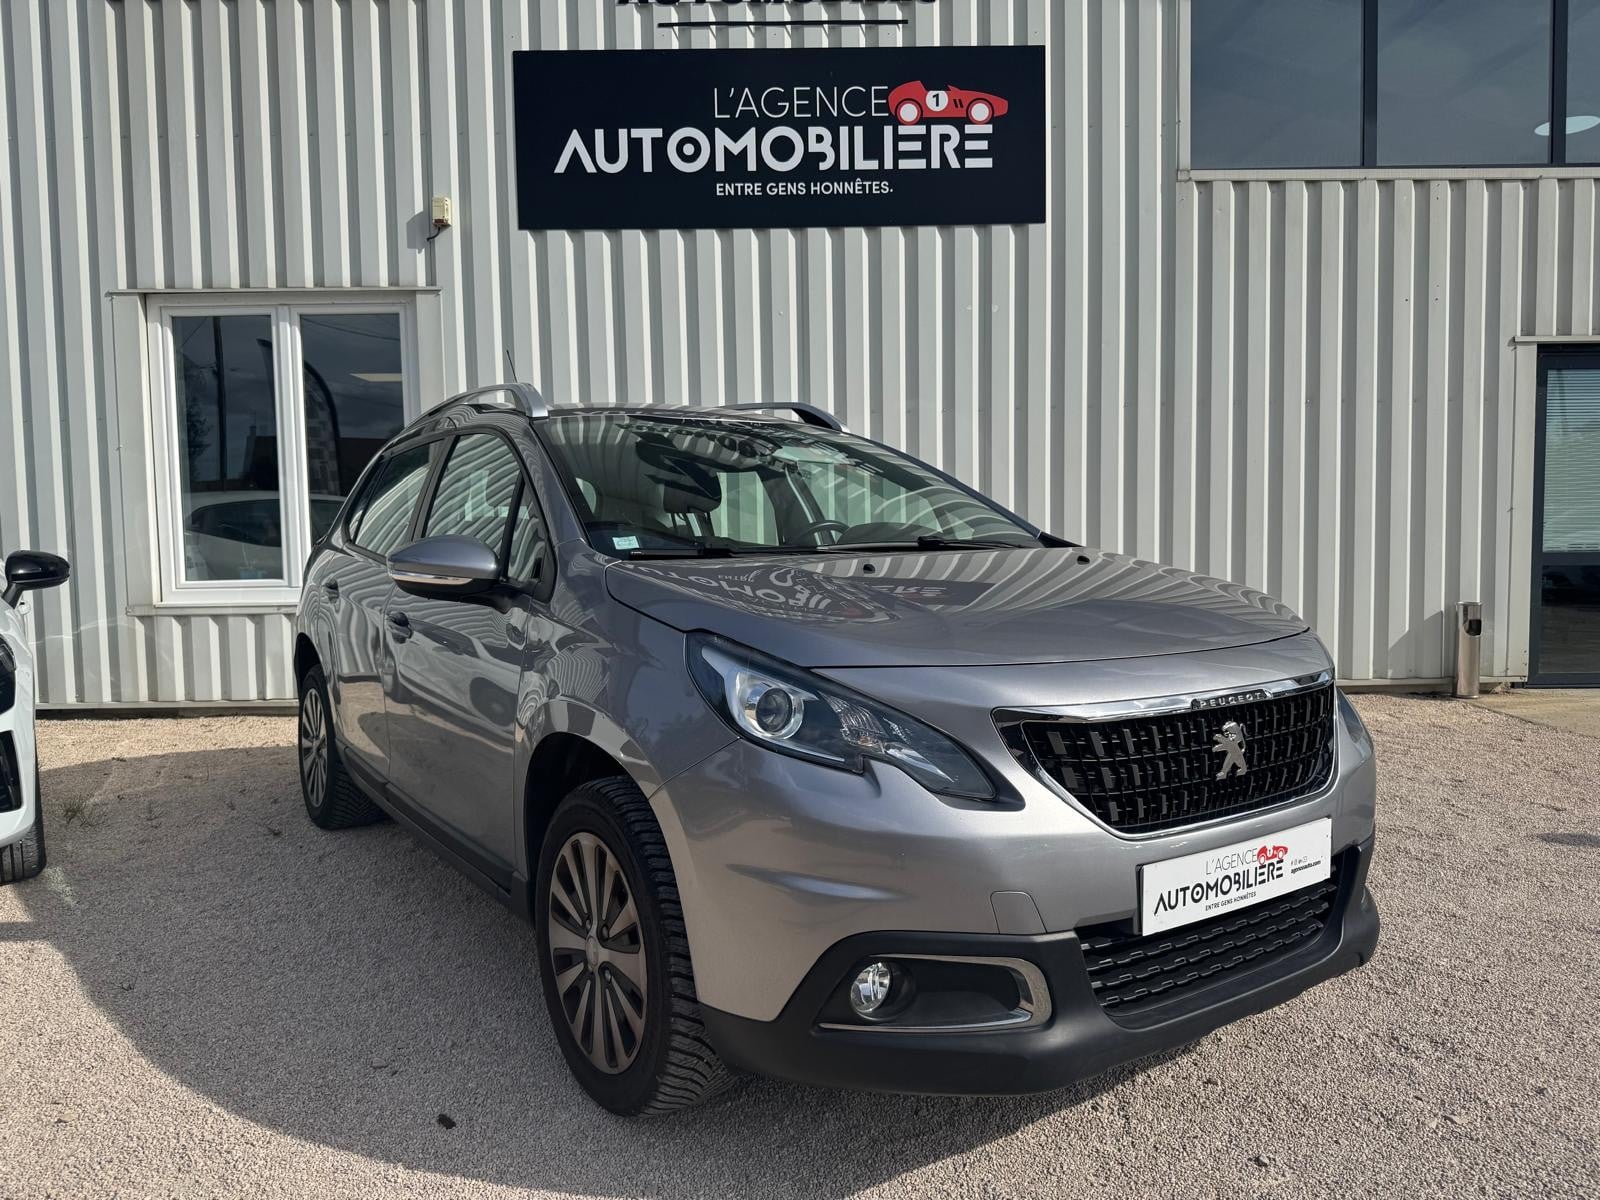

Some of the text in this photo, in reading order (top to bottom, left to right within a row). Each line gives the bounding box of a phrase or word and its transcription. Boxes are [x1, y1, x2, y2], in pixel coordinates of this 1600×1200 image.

[714, 85, 889, 119] L'AGENCE
[932, 93, 940, 108] 1
[553, 123, 993, 174] AUTOMOBILIERE
[716, 178, 894, 196] ENTRE GENS HONNÊTES.
[1200, 691, 1261, 708] PEUGEOT
[1206, 847, 1258, 875] L'AGENCE
[1205, 902, 1220, 911] ENTRE
[1220, 898, 1233, 906] GENS
